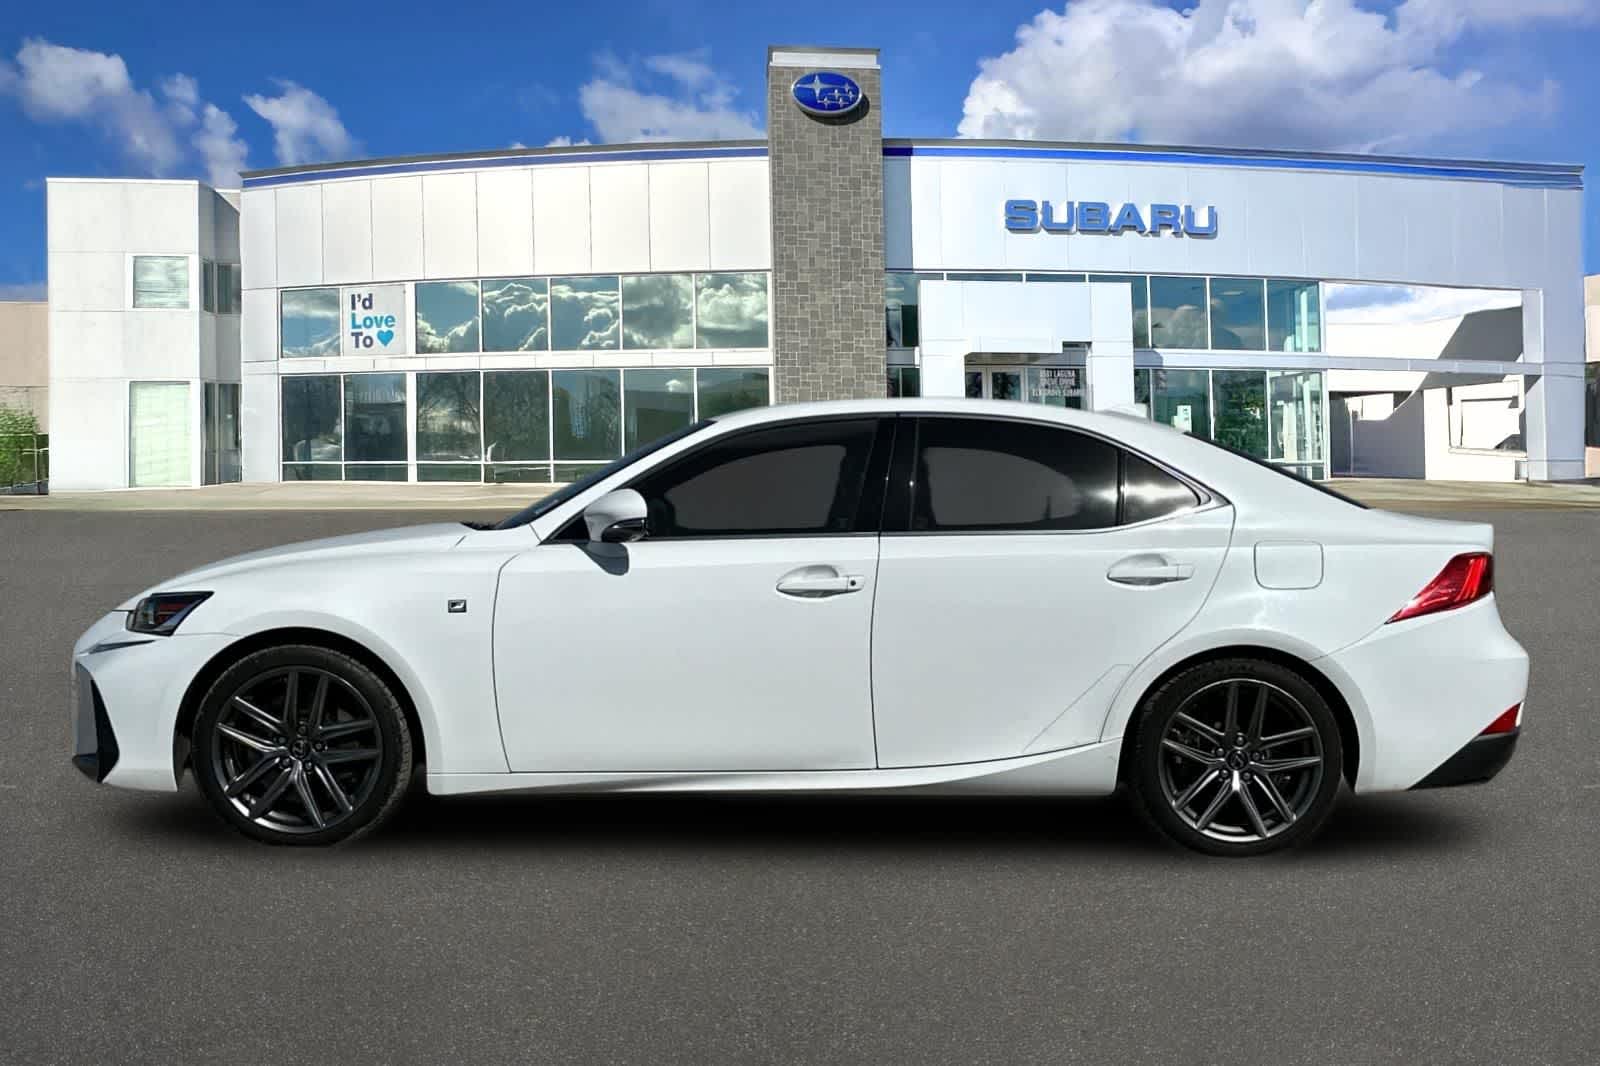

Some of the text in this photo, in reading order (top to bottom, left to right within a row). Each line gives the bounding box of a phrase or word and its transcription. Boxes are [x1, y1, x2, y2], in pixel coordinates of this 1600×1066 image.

[1005, 199, 1218, 237] SUBARU
[351, 293, 373, 310] I'd
[351, 313, 396, 329] Love
[351, 331, 374, 349] To
